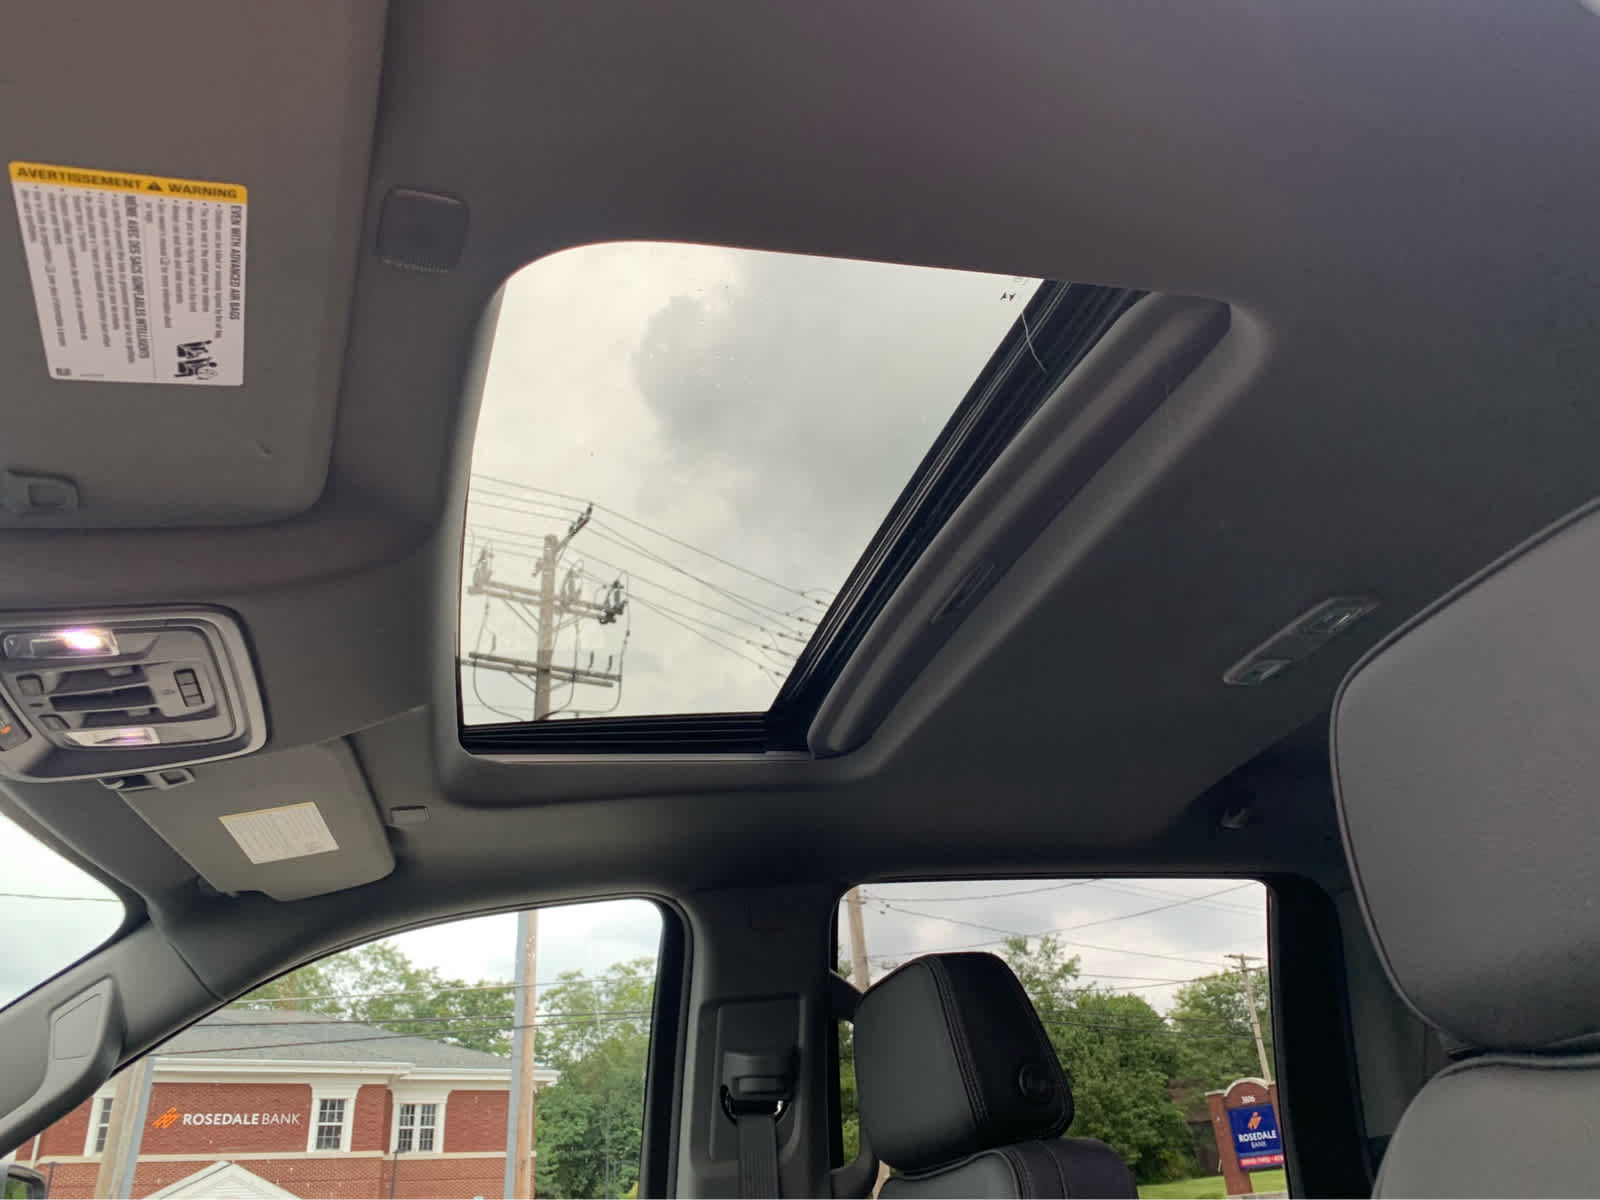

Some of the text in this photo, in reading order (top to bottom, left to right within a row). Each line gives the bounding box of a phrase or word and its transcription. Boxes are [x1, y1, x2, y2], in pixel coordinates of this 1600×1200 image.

[18, 167, 238, 199] AVERTISSEMENT WARNING
[127, 219, 140, 239] AVEC
[128, 240, 142, 254] DES
[130, 256, 143, 273] SACS
[230, 205, 242, 320] EVEN WITH ADVANCED AIR BAGS
[182, 1113, 300, 1125] ROSEDALE BANK
[1238, 1130, 1277, 1142] ROSEDALE
